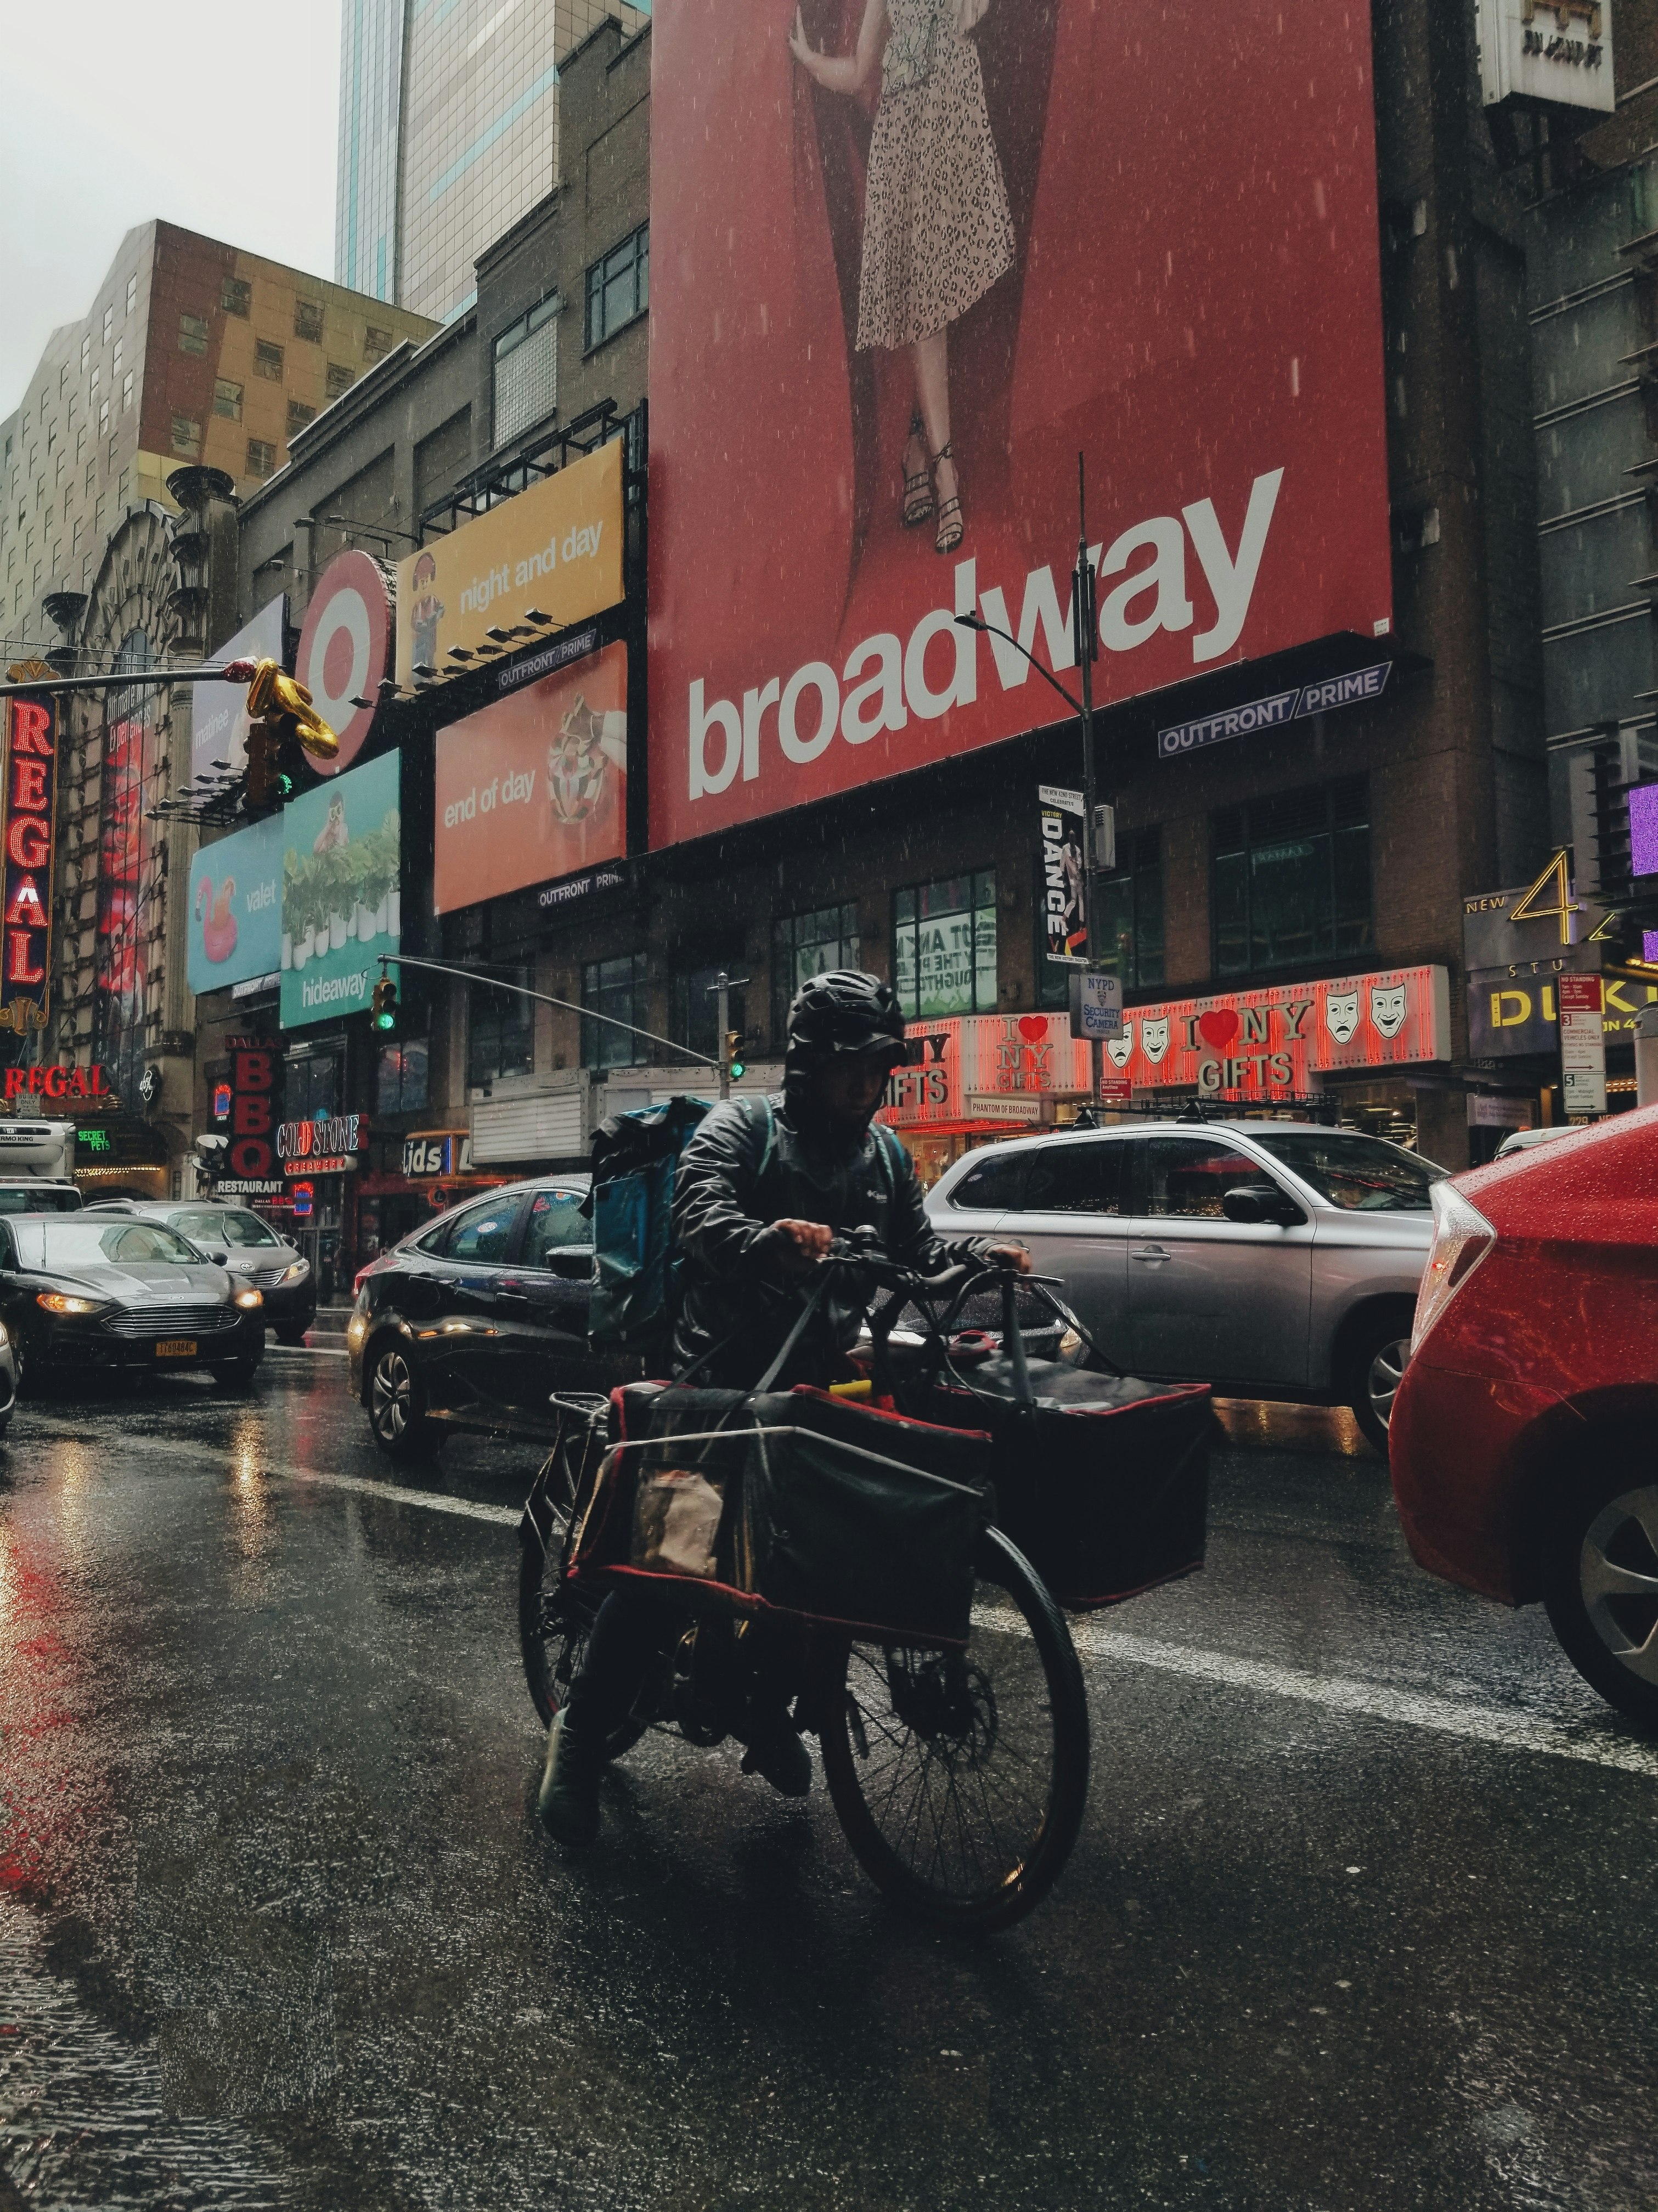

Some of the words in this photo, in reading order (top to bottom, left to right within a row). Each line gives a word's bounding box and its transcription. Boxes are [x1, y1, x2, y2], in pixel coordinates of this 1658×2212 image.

[460, 566, 510, 614] night
[516, 536, 555, 588] and
[562, 521, 603, 571] day
[689, 466, 1285, 801] broadway
[501, 651, 556, 686] OUTFRONT
[562, 634, 592, 658] PRIME
[1164, 696, 1292, 752] OUTFRONT
[1306, 670, 1380, 710] PRIME
[195, 708, 229, 750] matinee
[445, 788, 476, 827] end
[481, 776, 497, 812] of
[501, 771, 535, 808] day
[1041, 810, 1062, 819] VICTORY
[7, 702, 55, 983] REGAL
[539, 879, 591, 906] OUTFRONT
[1042, 817, 1067, 936] DANCE
[246, 883, 275, 913] valet
[1467, 896, 1505, 914] NEW
[302, 970, 367, 1008] hideaway
[1088, 978, 1114, 990] NYPD
[1002, 1017, 1017, 1042] I
[1180, 1014, 1200, 1052] I
[1236, 998, 1314, 1046] NY
[1563, 1015, 1571, 1026] 3
[996, 1043, 1054, 1070] NY
[1198, 1052, 1293, 1092] GIFTS
[4, 1064, 110, 1098] REGAL
[883, 1069, 948, 1108] IFTS
[996, 1071, 1051, 1089] GIFTS
[1566, 1075, 1574, 1086] 5
[231, 1051, 273, 1178] BBQ
[973, 1103, 1000, 1113] PHANTOM
[1001, 1104, 1008, 1113] OF
[1009, 1104, 1039, 1115] BROADWAY
[78, 1131, 106, 1141] SECRET
[91, 1141, 110, 1151] PETS
[277, 1122, 312, 1158] COLD
[313, 1114, 359, 1156] STONE
[288, 1159, 346, 1173] CREAMERY
[403, 1140, 442, 1174] Lids
[218, 1180, 283, 1194] RESTAURANT
